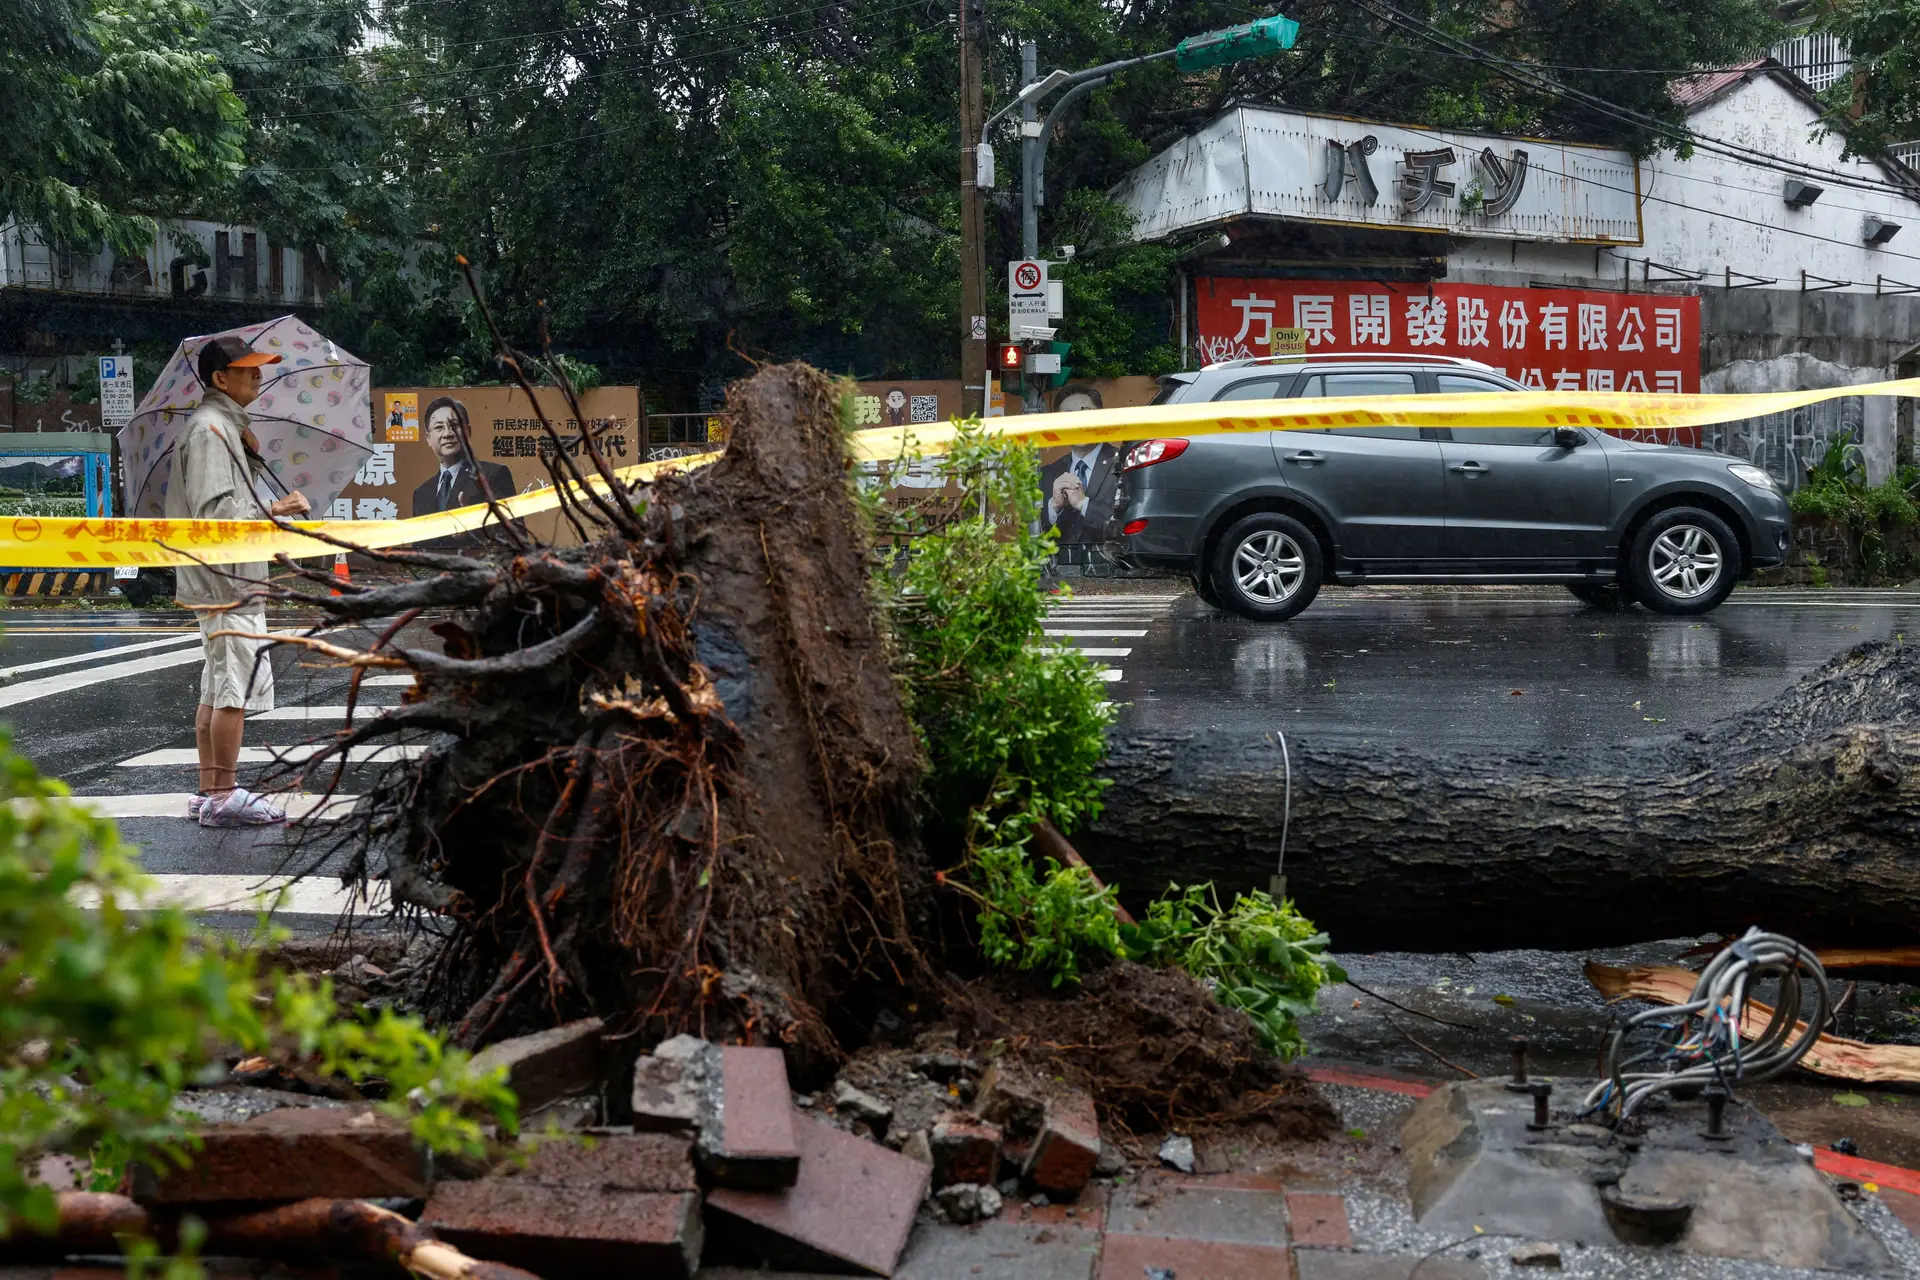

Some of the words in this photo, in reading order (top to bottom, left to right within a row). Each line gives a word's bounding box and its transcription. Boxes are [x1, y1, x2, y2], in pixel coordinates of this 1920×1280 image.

[1231, 293, 1682, 354] 方原開發股份有限公司
[1276, 331, 1300, 341] Only
[1274, 342, 1303, 350] Jesus
[854, 396, 882, 424] 我
